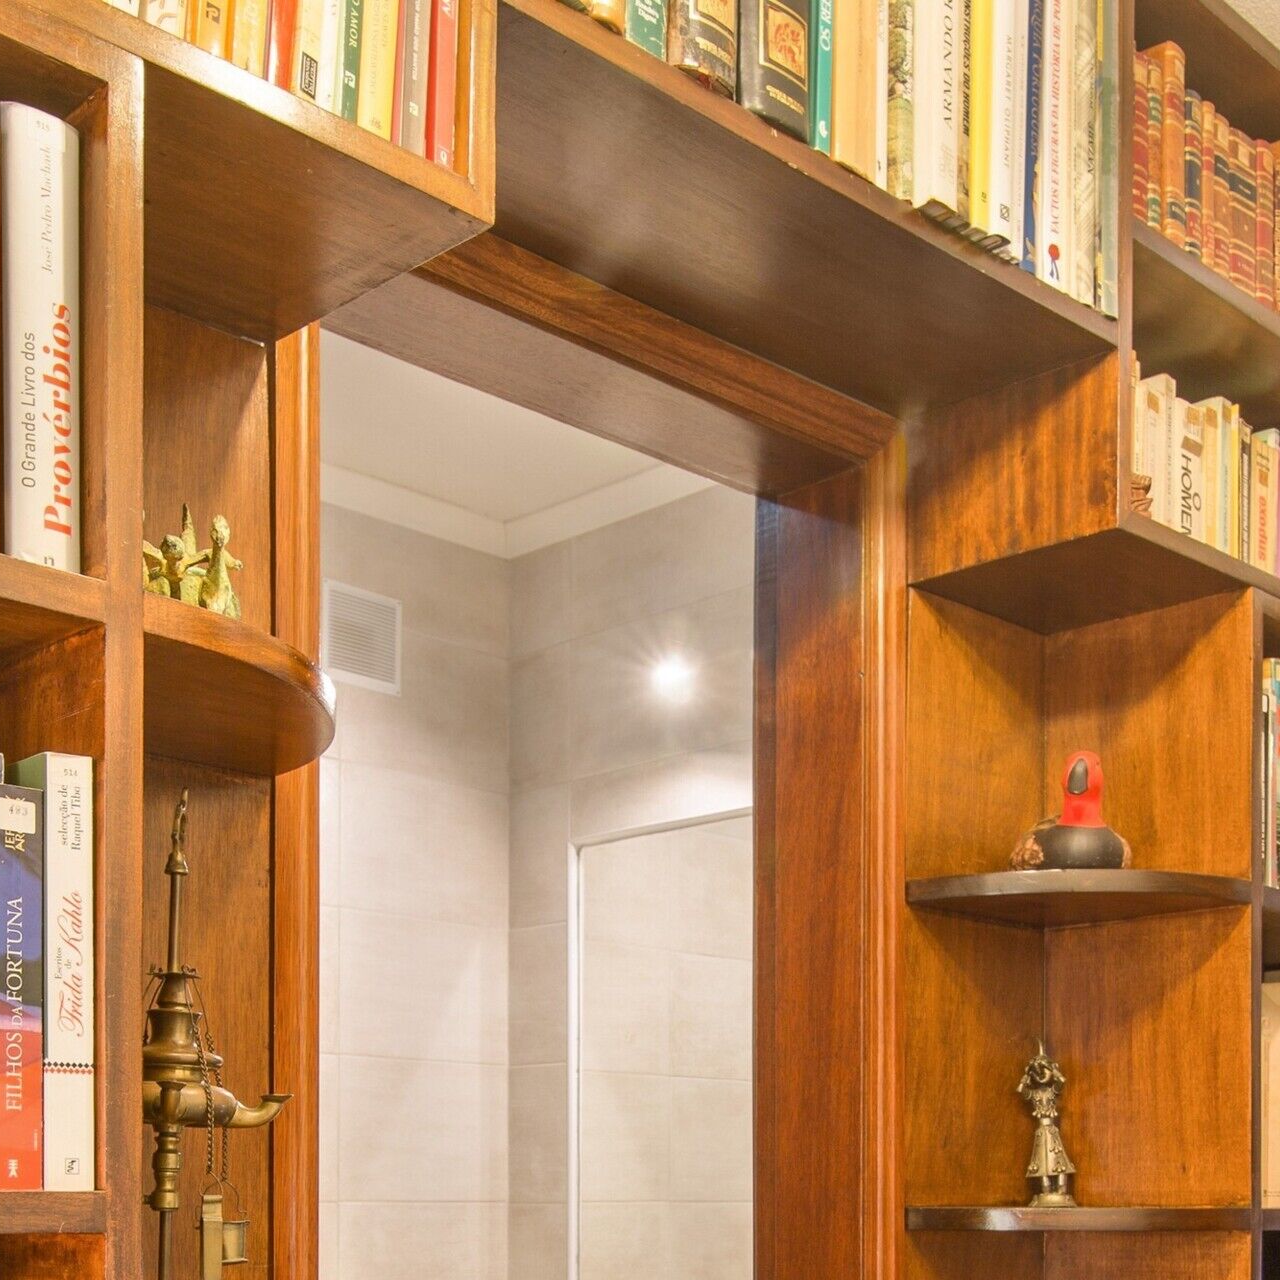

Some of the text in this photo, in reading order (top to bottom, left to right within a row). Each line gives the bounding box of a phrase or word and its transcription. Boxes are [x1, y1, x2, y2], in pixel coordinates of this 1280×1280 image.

[349, 13, 361, 47] AMOR
[943, 14, 954, 129] ARMANDO
[20, 332, 36, 488] O Grande Livro dos
[42, 302, 73, 537] Provérbios
[1258, 495, 1268, 561] exodus
[57, 890, 84, 967] Kahlo
[5, 896, 22, 1111] FILHOS DA FORTUNA
